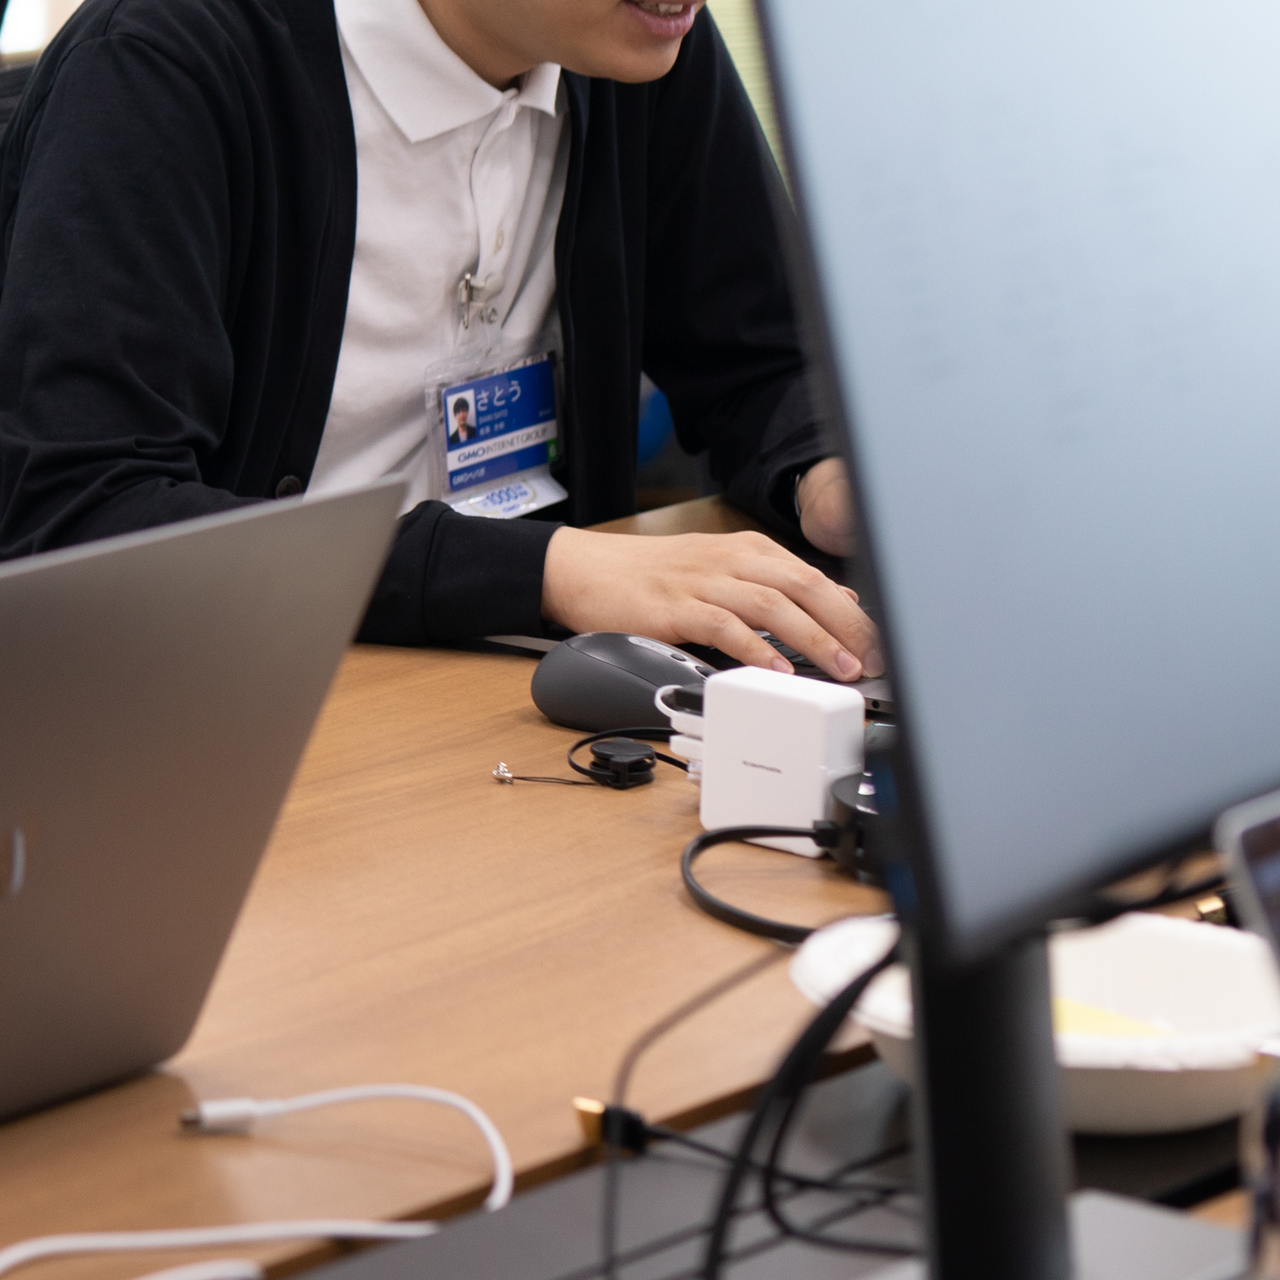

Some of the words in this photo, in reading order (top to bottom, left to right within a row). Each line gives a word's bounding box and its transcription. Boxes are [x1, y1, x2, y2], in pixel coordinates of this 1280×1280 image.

[476, 379, 521, 412] さとう
[457, 447, 486, 463] GMO
